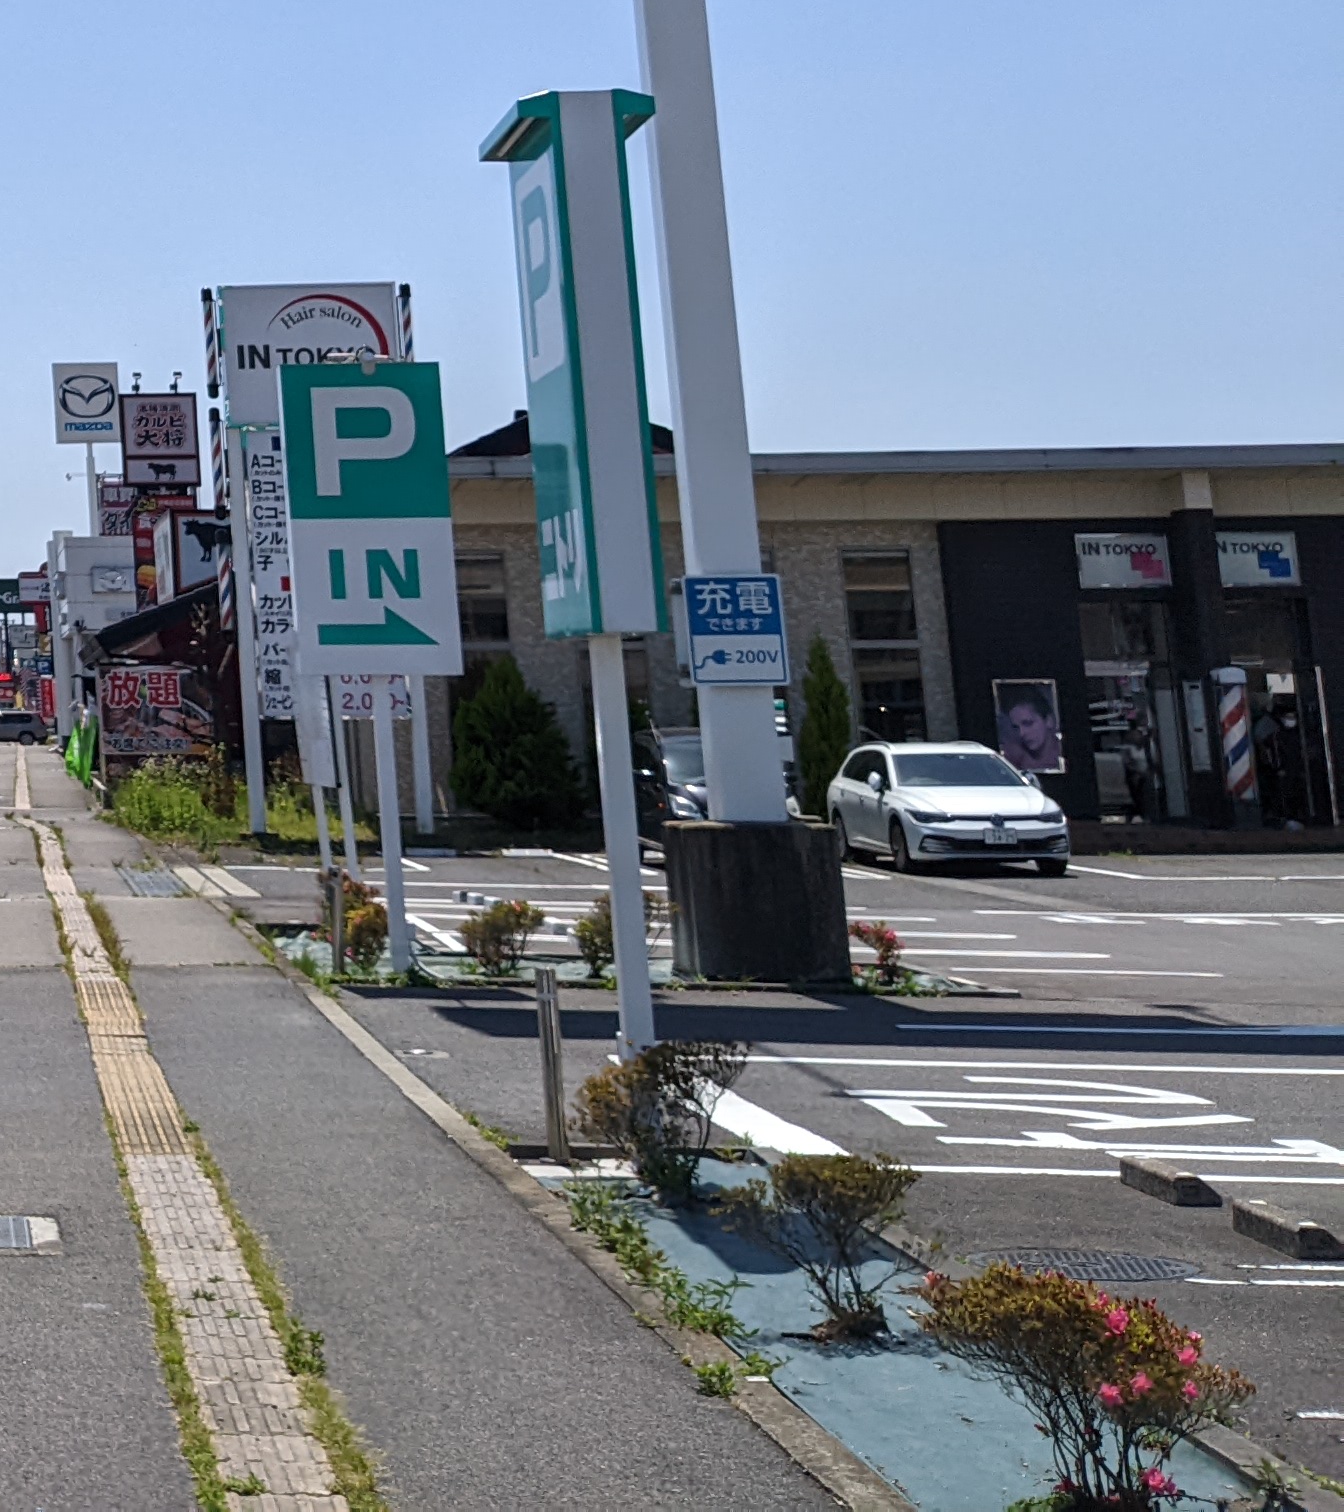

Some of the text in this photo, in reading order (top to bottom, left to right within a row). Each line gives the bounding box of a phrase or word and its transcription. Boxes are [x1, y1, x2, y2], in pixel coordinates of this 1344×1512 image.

[280, 305, 363, 330] Hair salon
[237, 344, 271, 370] IN
[135, 415, 185, 428] カルビ
[135, 429, 184, 447] 大将
[310, 386, 416, 497] P
[255, 532, 288, 546] シル
[1231, 541, 1284, 555] TOKYO
[1081, 541, 1157, 556] IN TOKYO
[329, 549, 421, 600] IN
[694, 581, 772, 615] 充電
[705, 617, 764, 631] できます
[735, 649, 779, 664] 200V
[107, 670, 181, 707] 放題
